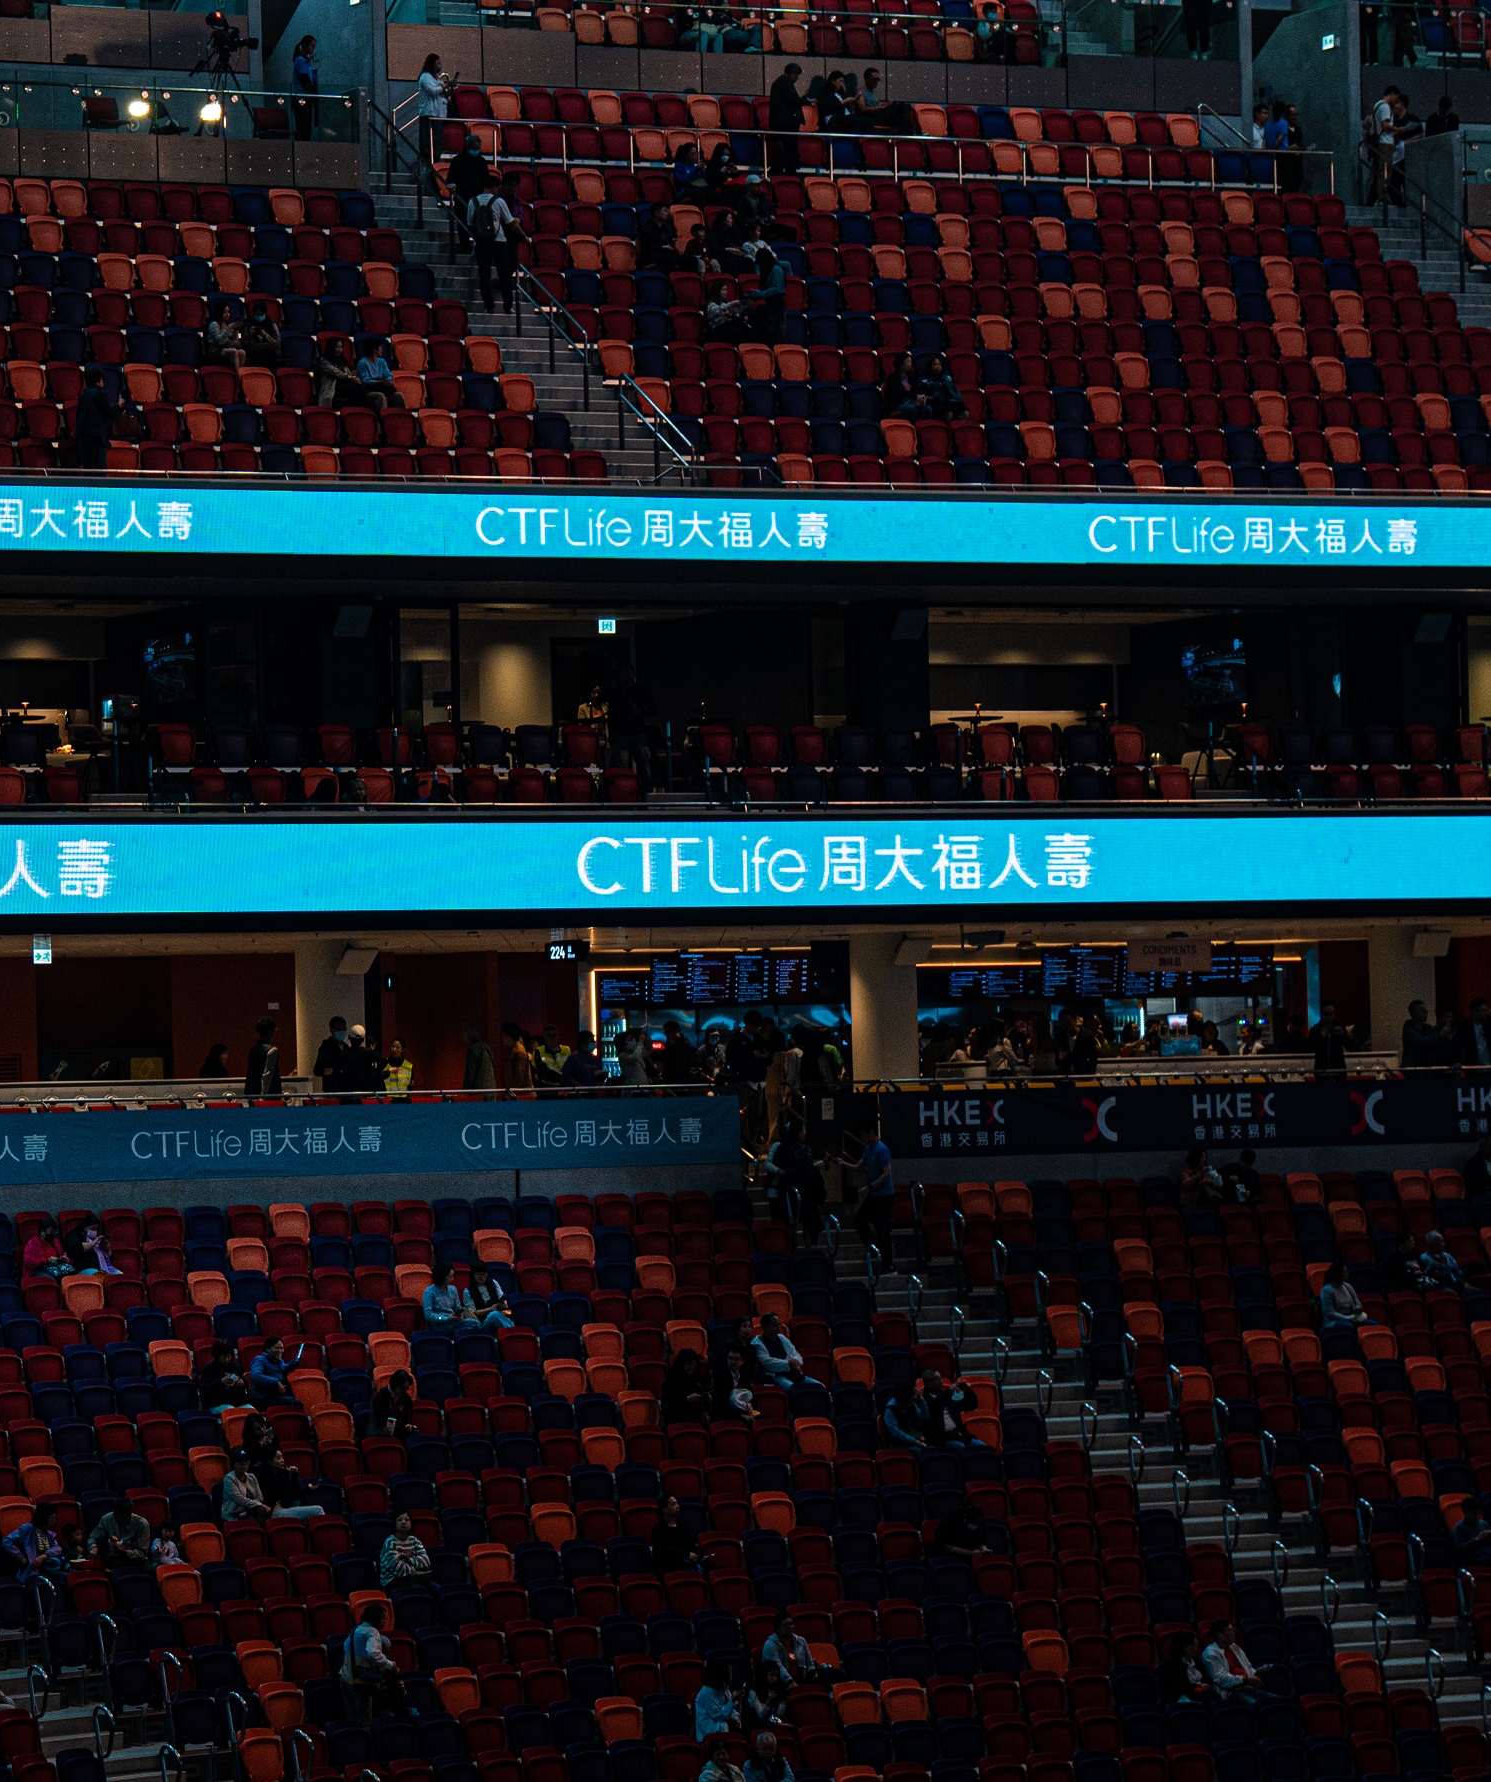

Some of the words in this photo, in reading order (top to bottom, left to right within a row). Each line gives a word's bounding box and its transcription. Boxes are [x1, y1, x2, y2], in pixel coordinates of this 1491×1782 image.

[476, 507, 631, 546] CTFLife
[643, 510, 828, 548] 周大福人壽
[1089, 516, 1234, 553] CTFLife
[1245, 518, 1417, 554] 周大福人壽
[578, 836, 806, 894] CTFLife
[820, 834, 1091, 891] 周大福人壽
[550, 945, 566, 960] 224
[1143, 945, 1197, 955] CONDIMENTS
[919, 1099, 1004, 1126] HKEX
[1193, 1093, 1275, 1119] HKEX
[131, 1130, 241, 1159] CTFLife
[249, 1126, 381, 1155] 周大福人壽
[461, 1122, 567, 1150] CTFLife
[575, 1118, 701, 1146] 周大福人壽
[921, 1131, 1005, 1147] 香港交易所
[1195, 1124, 1276, 1140] 香港交易所
